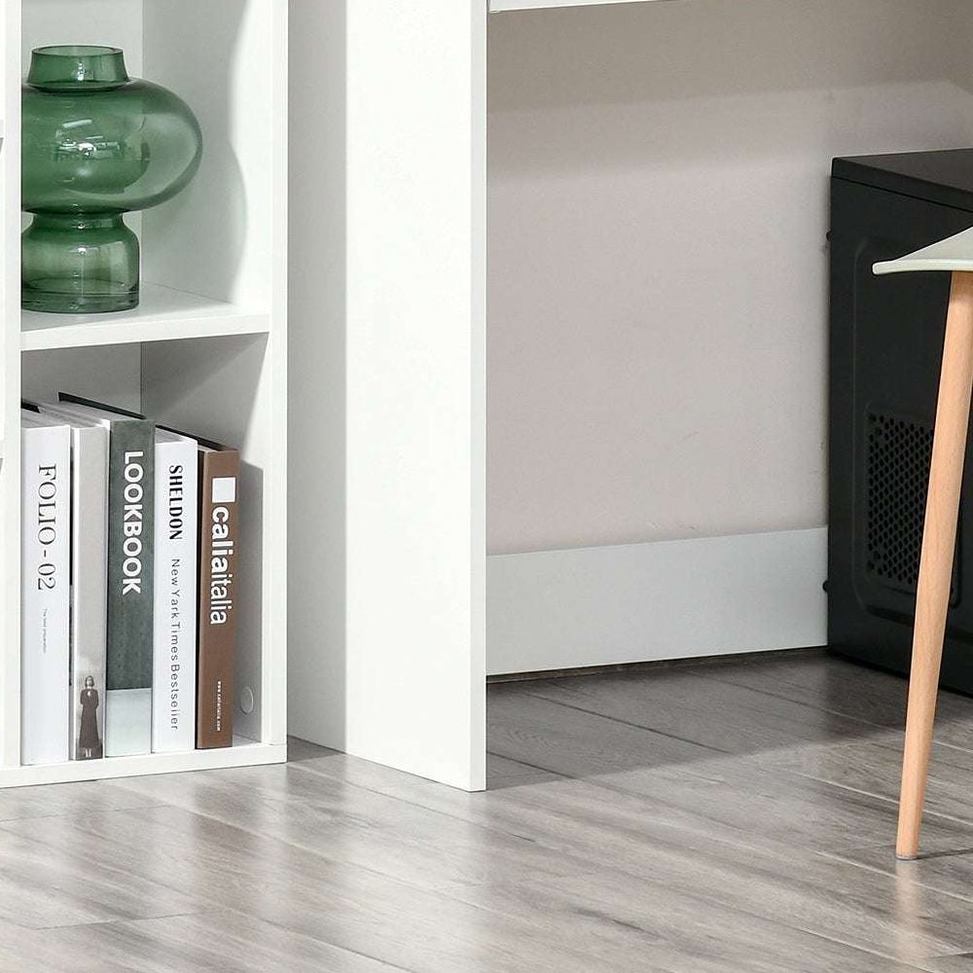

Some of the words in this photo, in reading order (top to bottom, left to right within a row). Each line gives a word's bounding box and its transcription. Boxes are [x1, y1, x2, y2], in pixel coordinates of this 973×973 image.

[122, 451, 144, 595] LOOKBOOK
[168, 464, 184, 540] SHELDON
[170, 558, 181, 586] New
[210, 506, 234, 625] caliaitalia
[170, 622, 181, 661] Times
